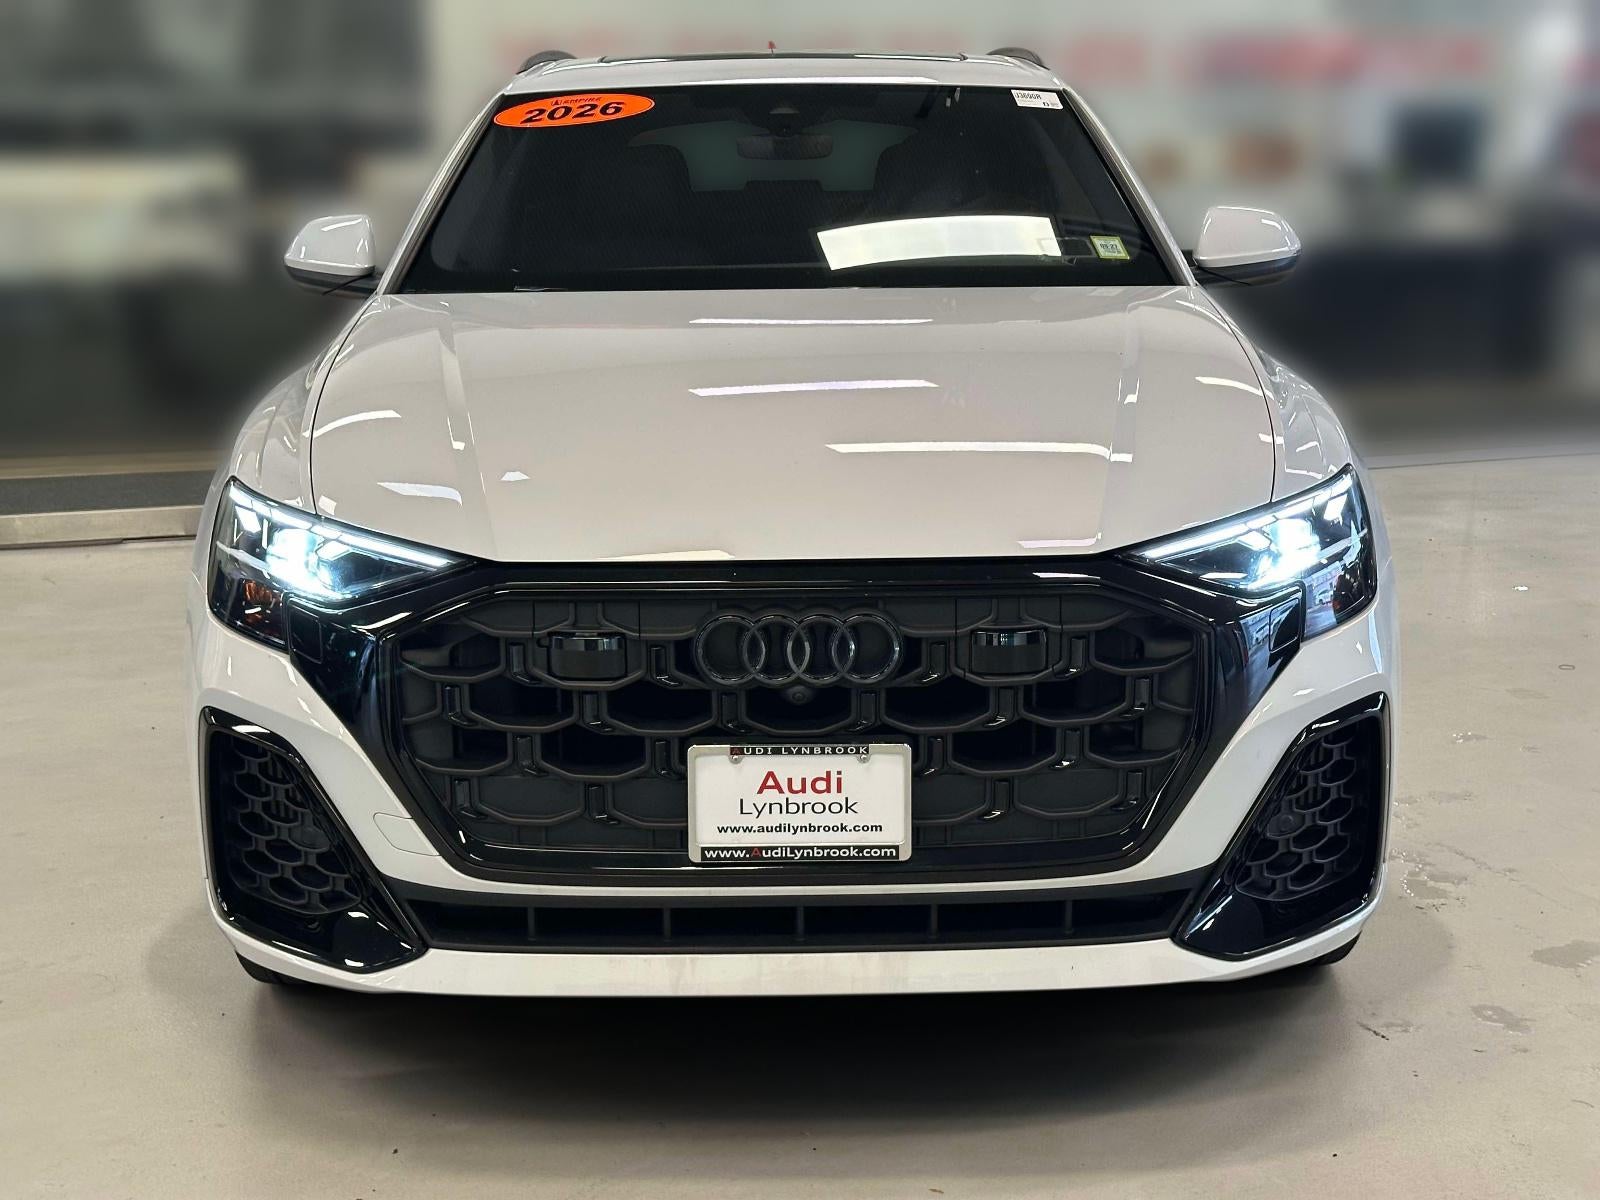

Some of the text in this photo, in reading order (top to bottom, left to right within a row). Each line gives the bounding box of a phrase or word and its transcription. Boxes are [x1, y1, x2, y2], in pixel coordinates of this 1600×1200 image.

[520, 102, 624, 124] 2026
[732, 745, 868, 755] AUDI LYNBROOK
[756, 770, 843, 795] Audi
[739, 797, 859, 819] Lynbrook
[717, 823, 883, 835] www.audilynbrook.com
[704, 847, 896, 860] www.AudiLynbrook.com
